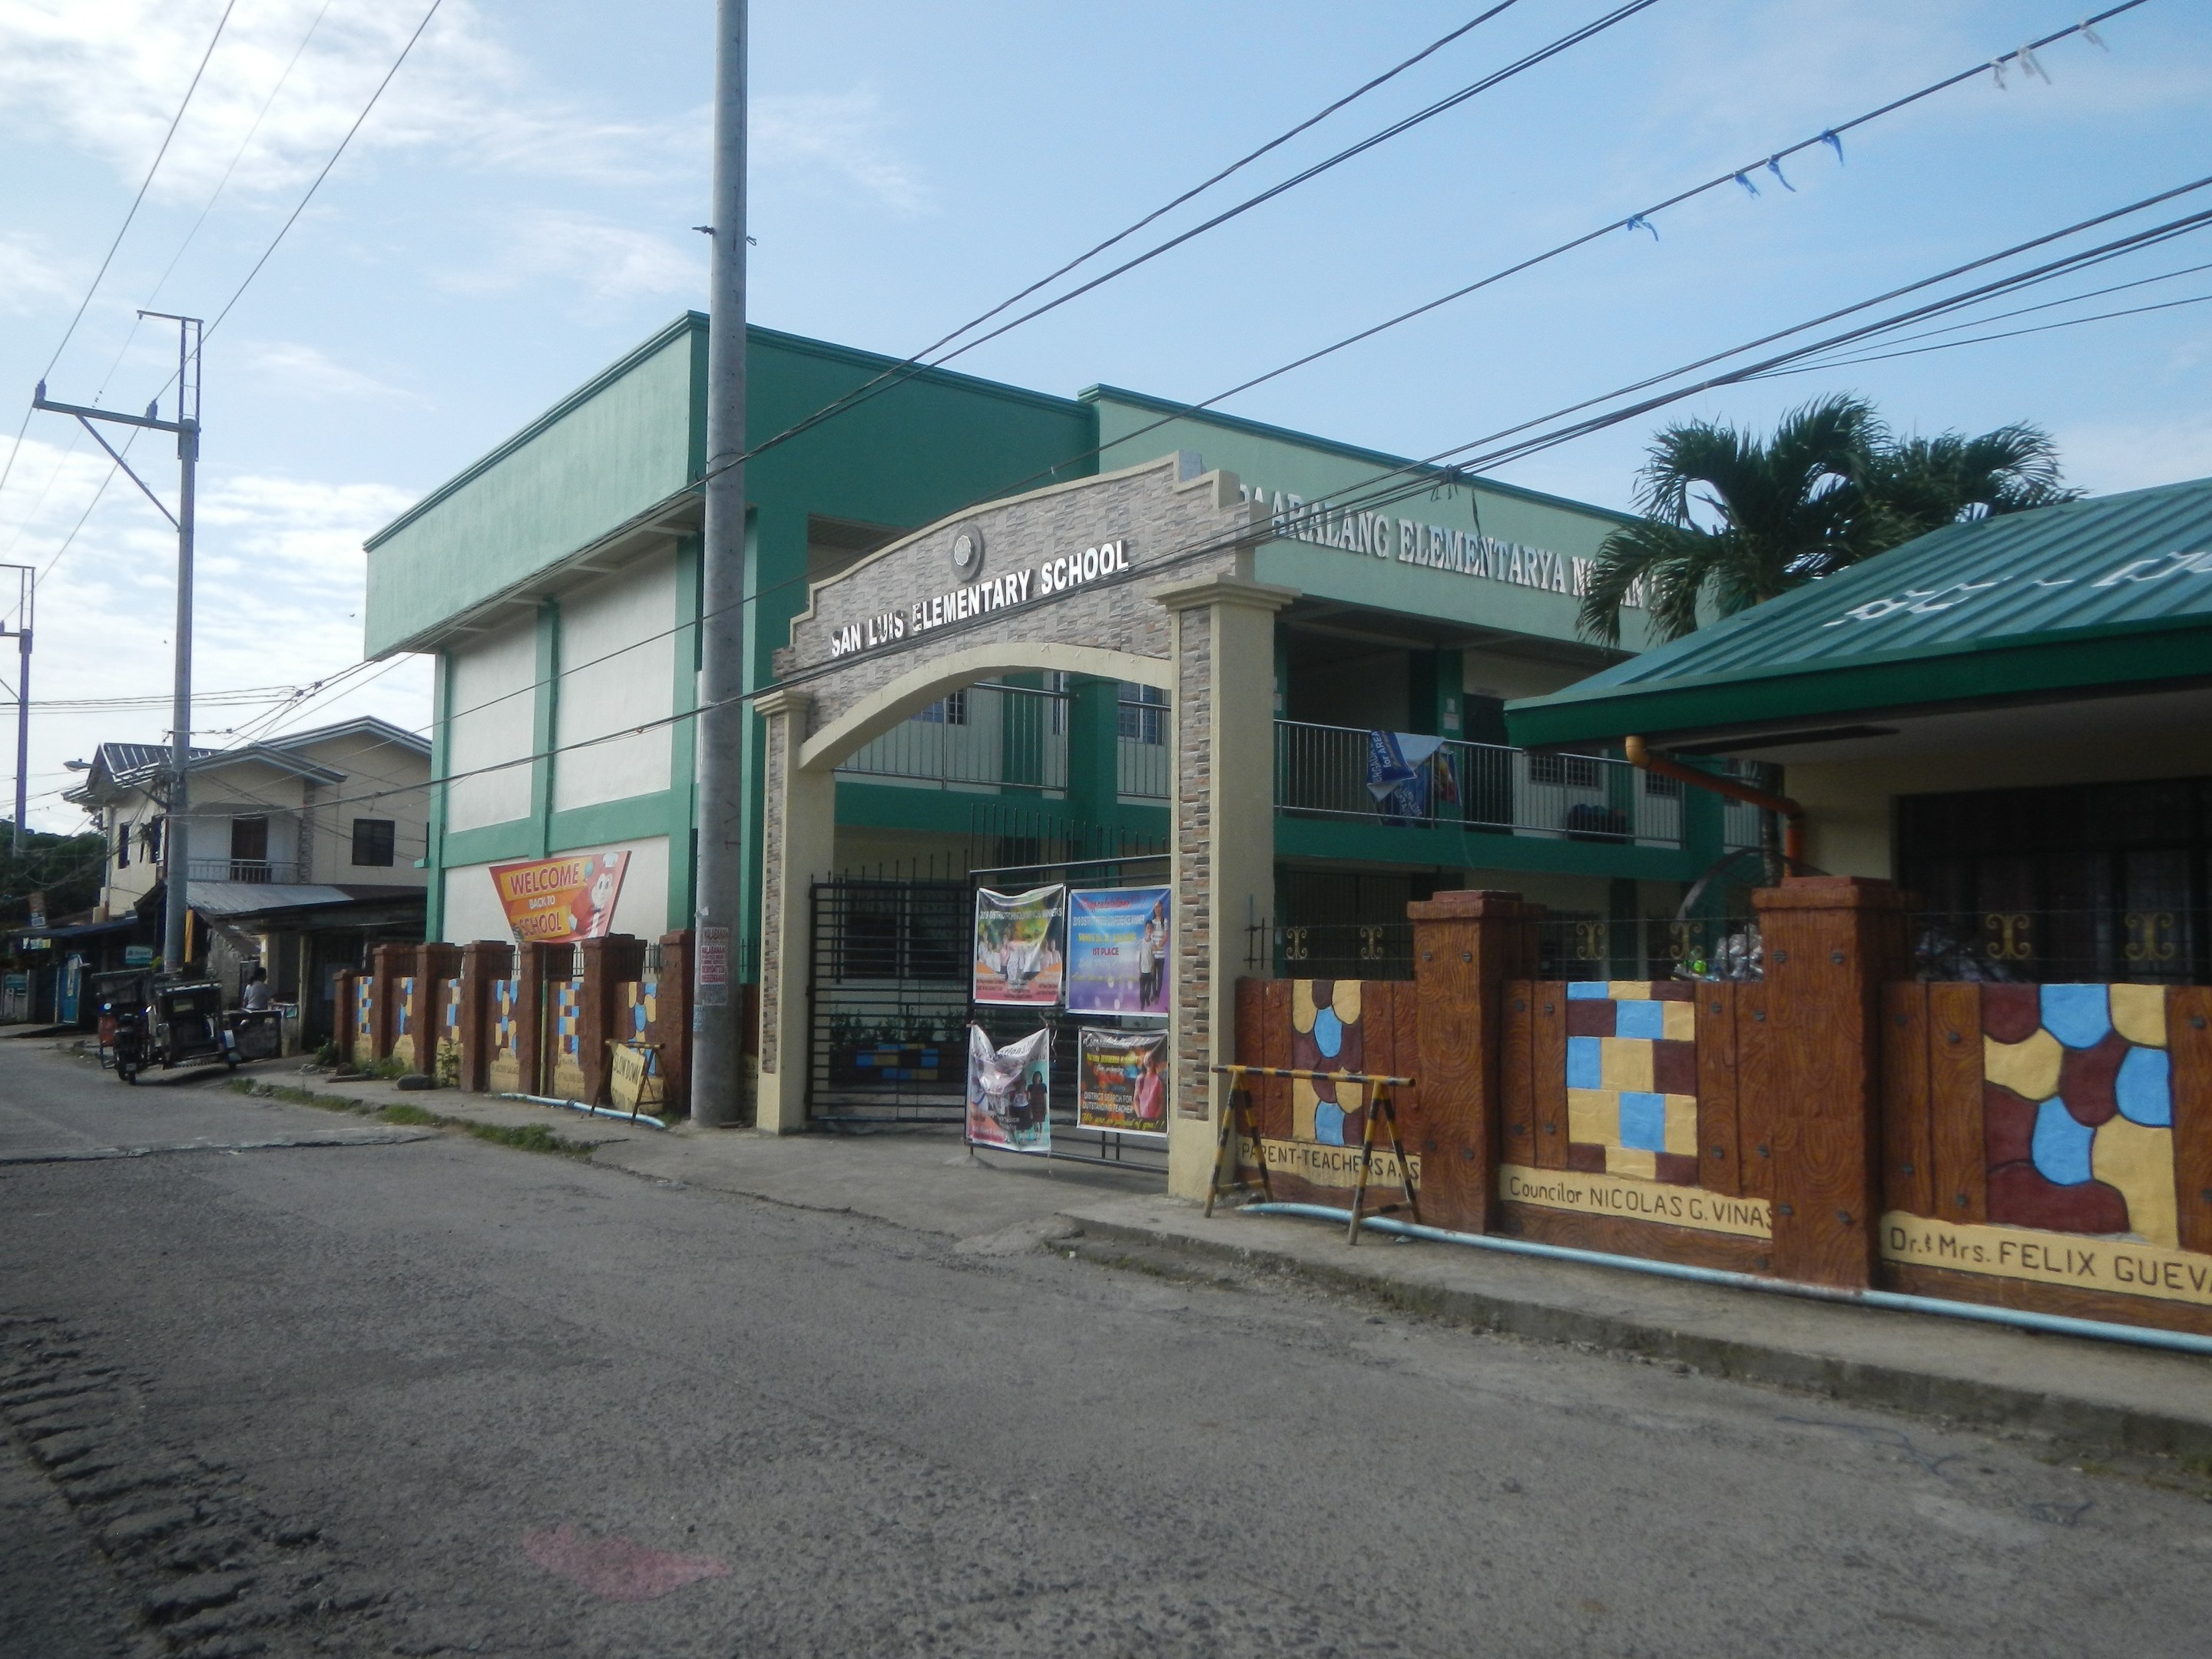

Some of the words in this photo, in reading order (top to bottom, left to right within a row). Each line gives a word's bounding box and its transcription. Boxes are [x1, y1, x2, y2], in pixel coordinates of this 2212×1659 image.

[1240, 484, 1389, 558] ARALANG
[1399, 518, 1566, 594] ELEMENTARYA
[831, 623, 861, 657] SAN
[869, 611, 904, 647] LUIS
[912, 569, 1031, 632] ELEMENTARY
[1041, 541, 1128, 594] SCHOOL
[1372, 730, 1386, 754] AREA
[1382, 756, 1391, 768] for
[510, 863, 581, 896] WELCOME
[528, 896, 547, 909] BACK
[547, 896, 556, 906] TO
[519, 912, 562, 937] SCHOOL
[1101, 947, 1119, 956] PLACE
[1509, 1177, 1582, 1204] Councilor
[1590, 1187, 1682, 1217] NICOLAS
[1689, 1198, 1708, 1221] G.
[1999, 1240, 2096, 1277] FELIX
[2114, 1255, 2212, 1293] GUEV
